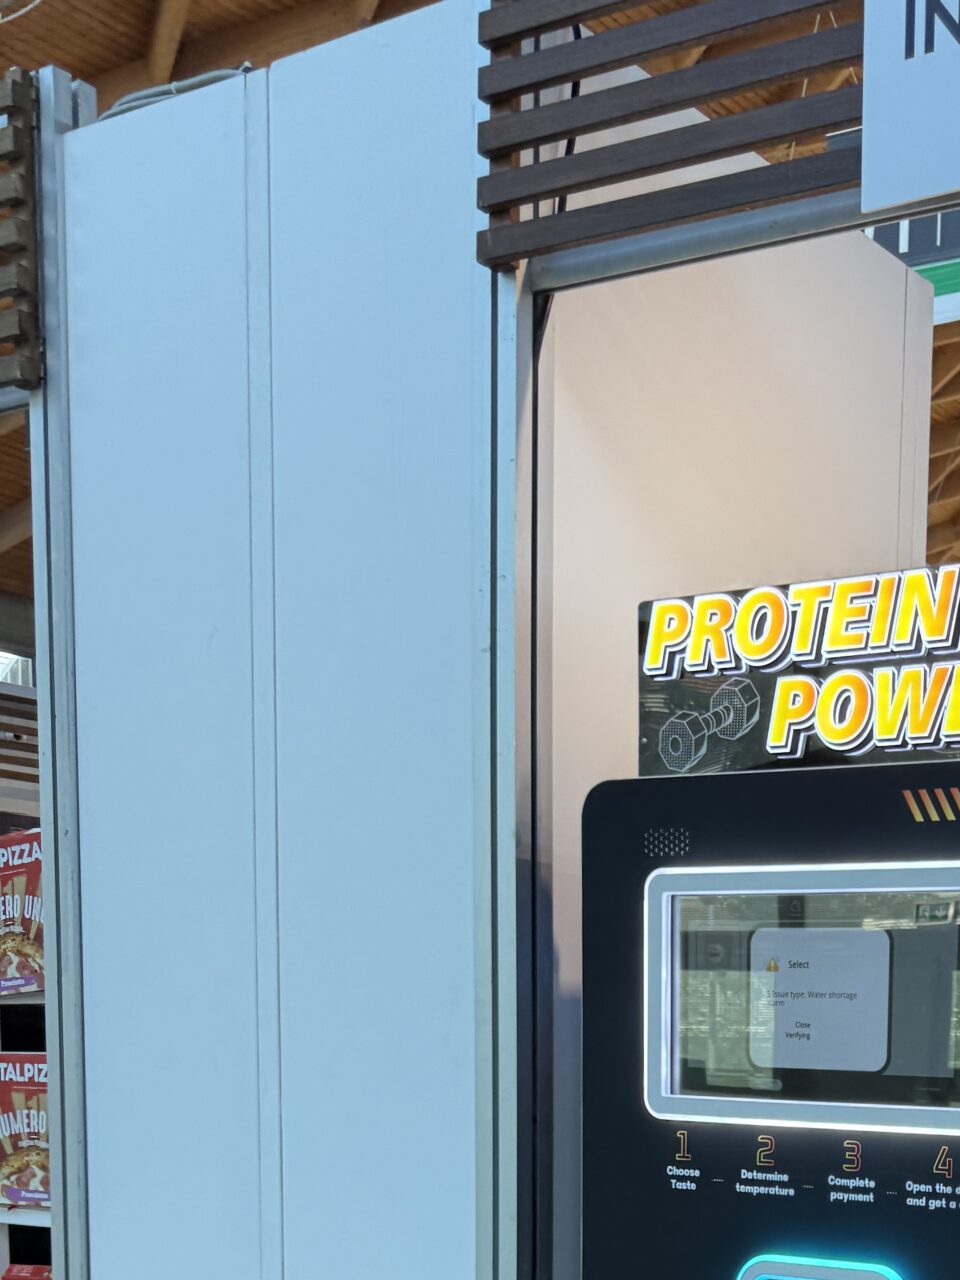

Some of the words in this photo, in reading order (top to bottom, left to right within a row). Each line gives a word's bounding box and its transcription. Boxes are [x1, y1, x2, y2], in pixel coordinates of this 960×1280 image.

[788, 960, 810, 969] Select
[790, 991, 806, 1000] type:
[807, 991, 827, 999] Water
[828, 991, 858, 1001] shortage
[795, 1021, 811, 1029] Close
[785, 1032, 811, 1041] Verifying
[676, 1130, 691, 1161] 1
[756, 1135, 775, 1166] 2
[842, 1140, 862, 1172] 3
[932, 1145, 953, 1178] 4
[666, 1165, 700, 1178] Choose
[740, 1168, 789, 1182] Determine
[670, 1179, 696, 1190] Taste
[827, 1174, 876, 1189] Complete
[905, 1181, 932, 1194] Open
[934, 1183, 952, 1194] the
[735, 1182, 795, 1196] temperature
[830, 1191, 874, 1203] payment
[906, 1196, 926, 1207] and
[928, 1198, 946, 1210] get
[948, 1201, 957, 1209] a
